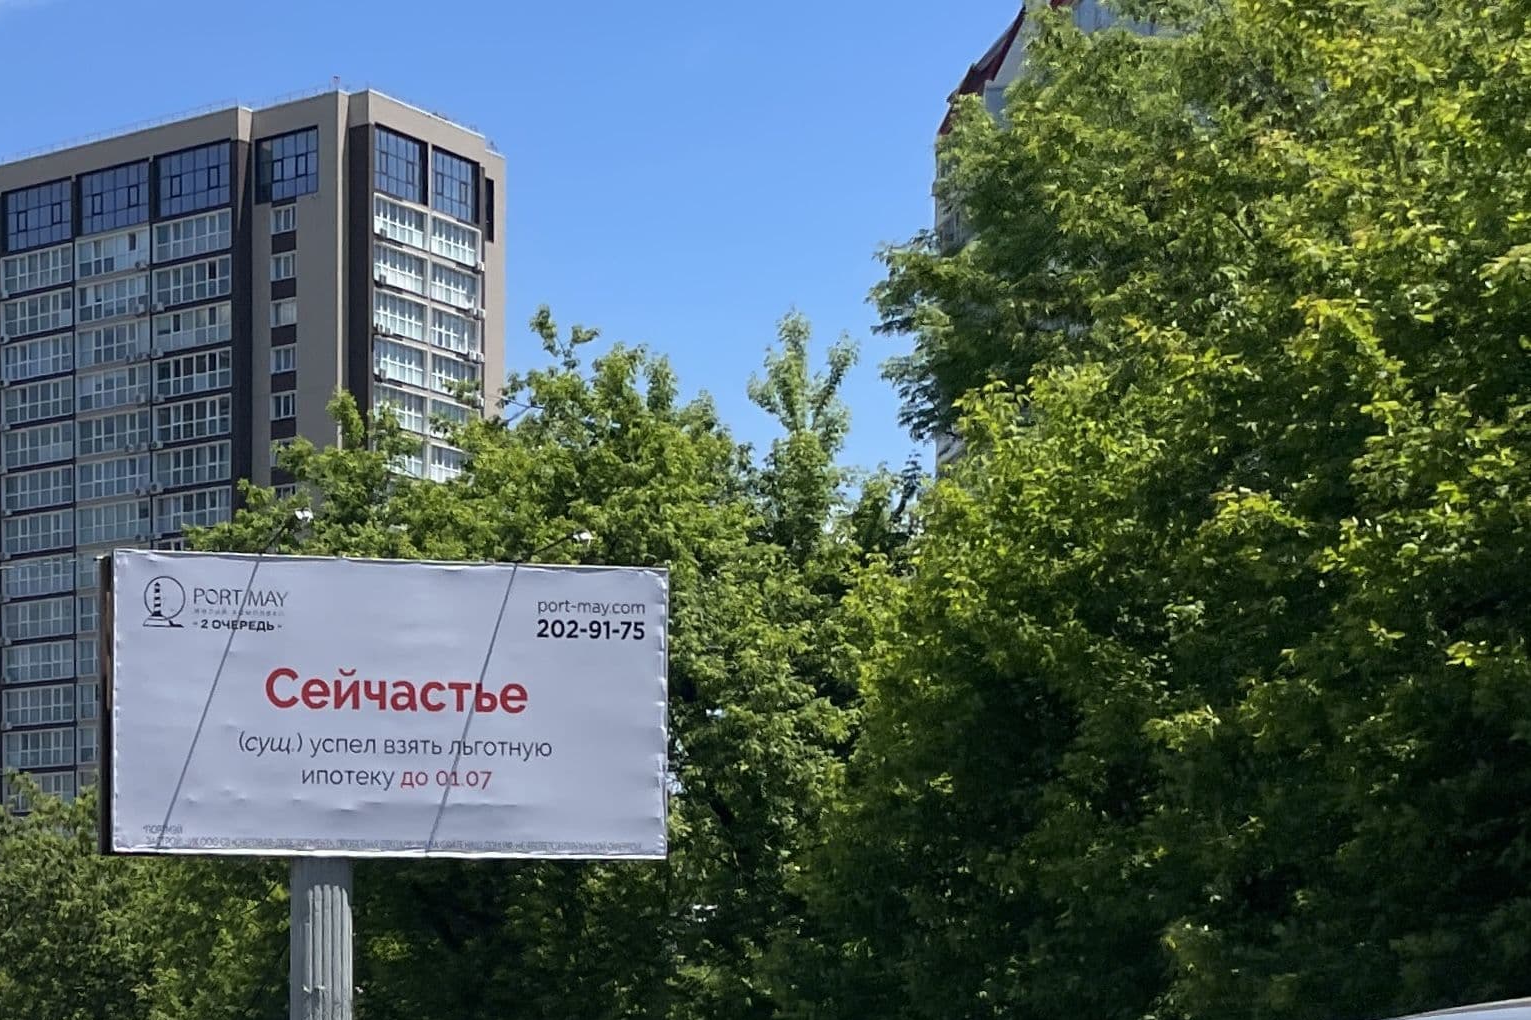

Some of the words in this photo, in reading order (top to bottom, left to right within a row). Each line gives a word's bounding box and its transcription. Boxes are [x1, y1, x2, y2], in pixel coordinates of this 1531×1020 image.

[247, 589, 289, 607] MAY
[537, 599, 646, 616] port-may.com
[211, 619, 275, 632] ОЧЕРЕДЬ
[536, 619, 646, 640] 202-91-75
[265, 667, 529, 714] Сейчастье
[309, 736, 377, 758] успел
[383, 738, 443, 756] взять
[448, 738, 553, 762] льготную
[301, 768, 395, 791] ипотеку
[400, 770, 429, 789] до
[435, 770, 493, 790] 01.07
